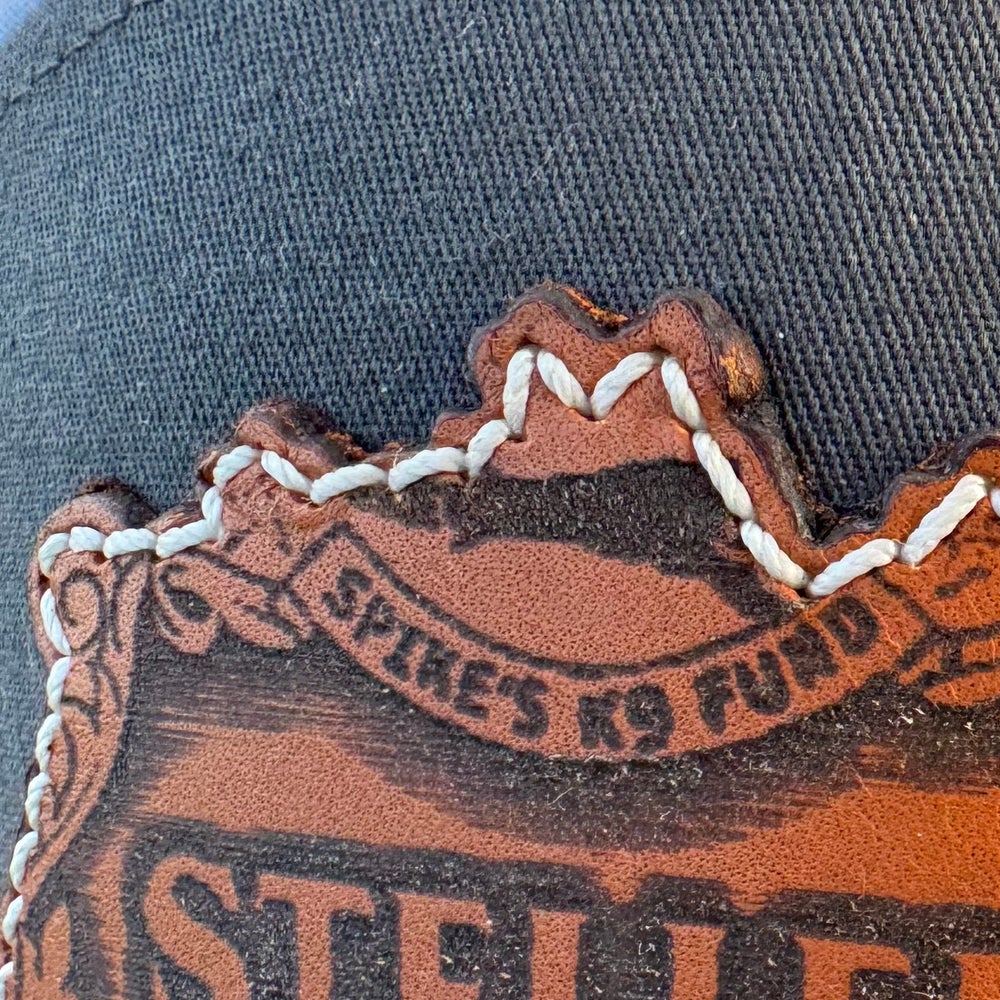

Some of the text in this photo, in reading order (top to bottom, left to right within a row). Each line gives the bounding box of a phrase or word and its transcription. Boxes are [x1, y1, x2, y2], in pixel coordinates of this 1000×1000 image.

[321, 567, 881, 753] SPIKE'S K9 FUND
